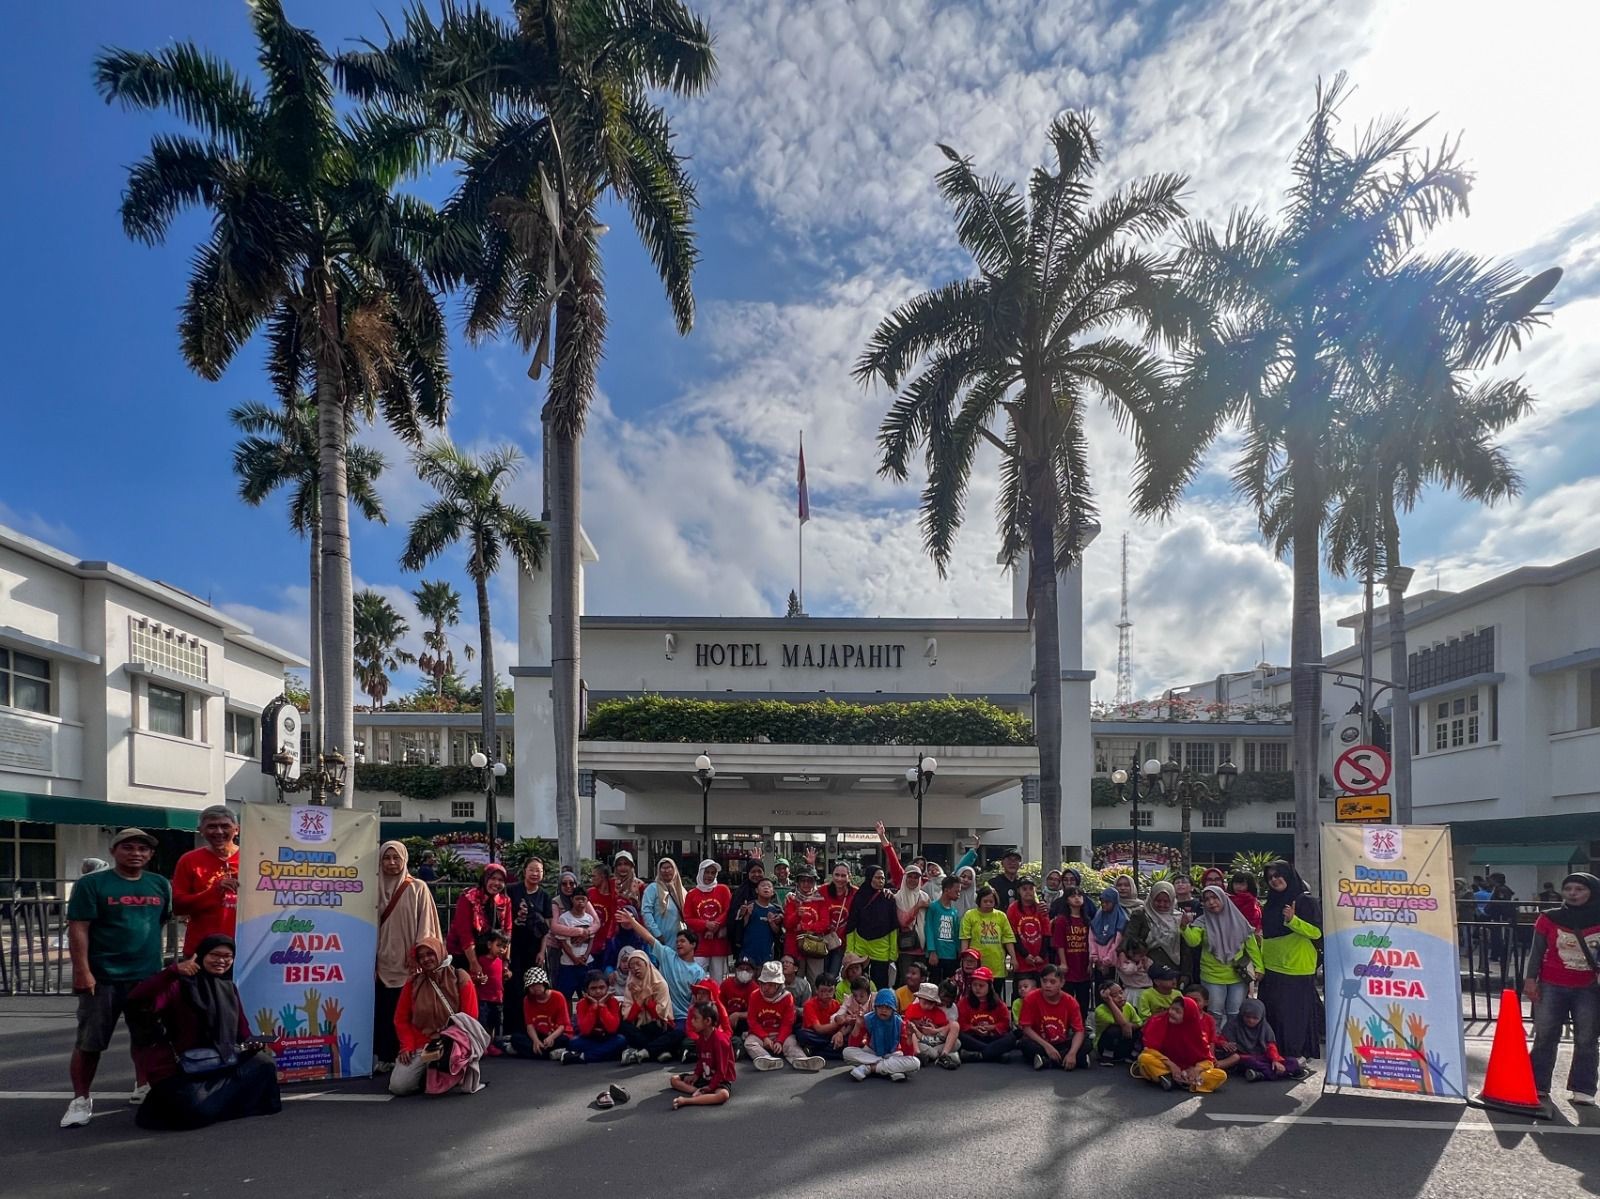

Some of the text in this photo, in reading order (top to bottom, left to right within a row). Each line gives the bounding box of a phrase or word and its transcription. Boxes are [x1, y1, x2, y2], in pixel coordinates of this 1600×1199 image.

[695, 643, 905, 669] HOTEL MAJAPAHIT
[1351, 754, 1373, 785] S
[278, 847, 336, 864] Down
[259, 860, 358, 879] Syndrome
[1355, 865, 1408, 881] Down
[256, 876, 363, 893] Awareness
[1339, 878, 1431, 896] Syndrome
[274, 890, 342, 906] Month
[1337, 893, 1438, 911] Awareness
[271, 915, 315, 933] aku
[1354, 907, 1417, 923] Month
[289, 933, 343, 951] ADA
[1353, 930, 1392, 948] aku
[270, 946, 314, 965] aku
[1369, 949, 1422, 968] ADA
[285, 965, 344, 983] BISA
[1354, 960, 1394, 978] aku
[1368, 979, 1426, 998] BISA
